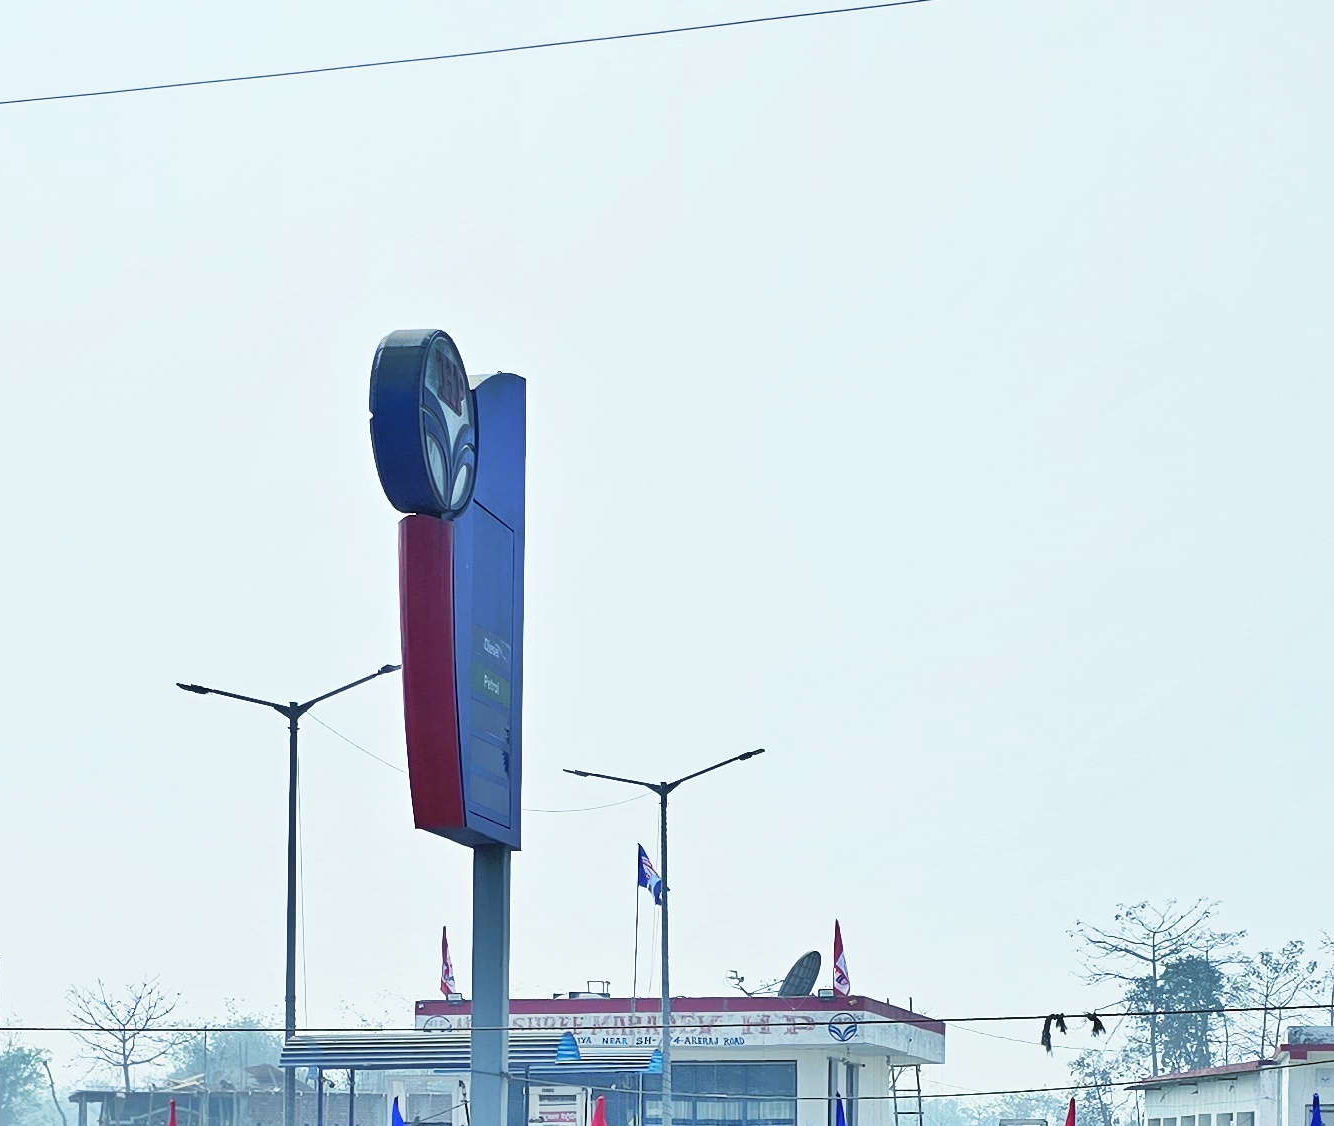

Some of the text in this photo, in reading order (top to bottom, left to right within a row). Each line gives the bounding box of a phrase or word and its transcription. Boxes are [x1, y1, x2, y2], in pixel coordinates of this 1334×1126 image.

[483, 674, 500, 695] Petrol
[602, 1036, 628, 1045] NEAR
[723, 1037, 745, 1046] ROAD
